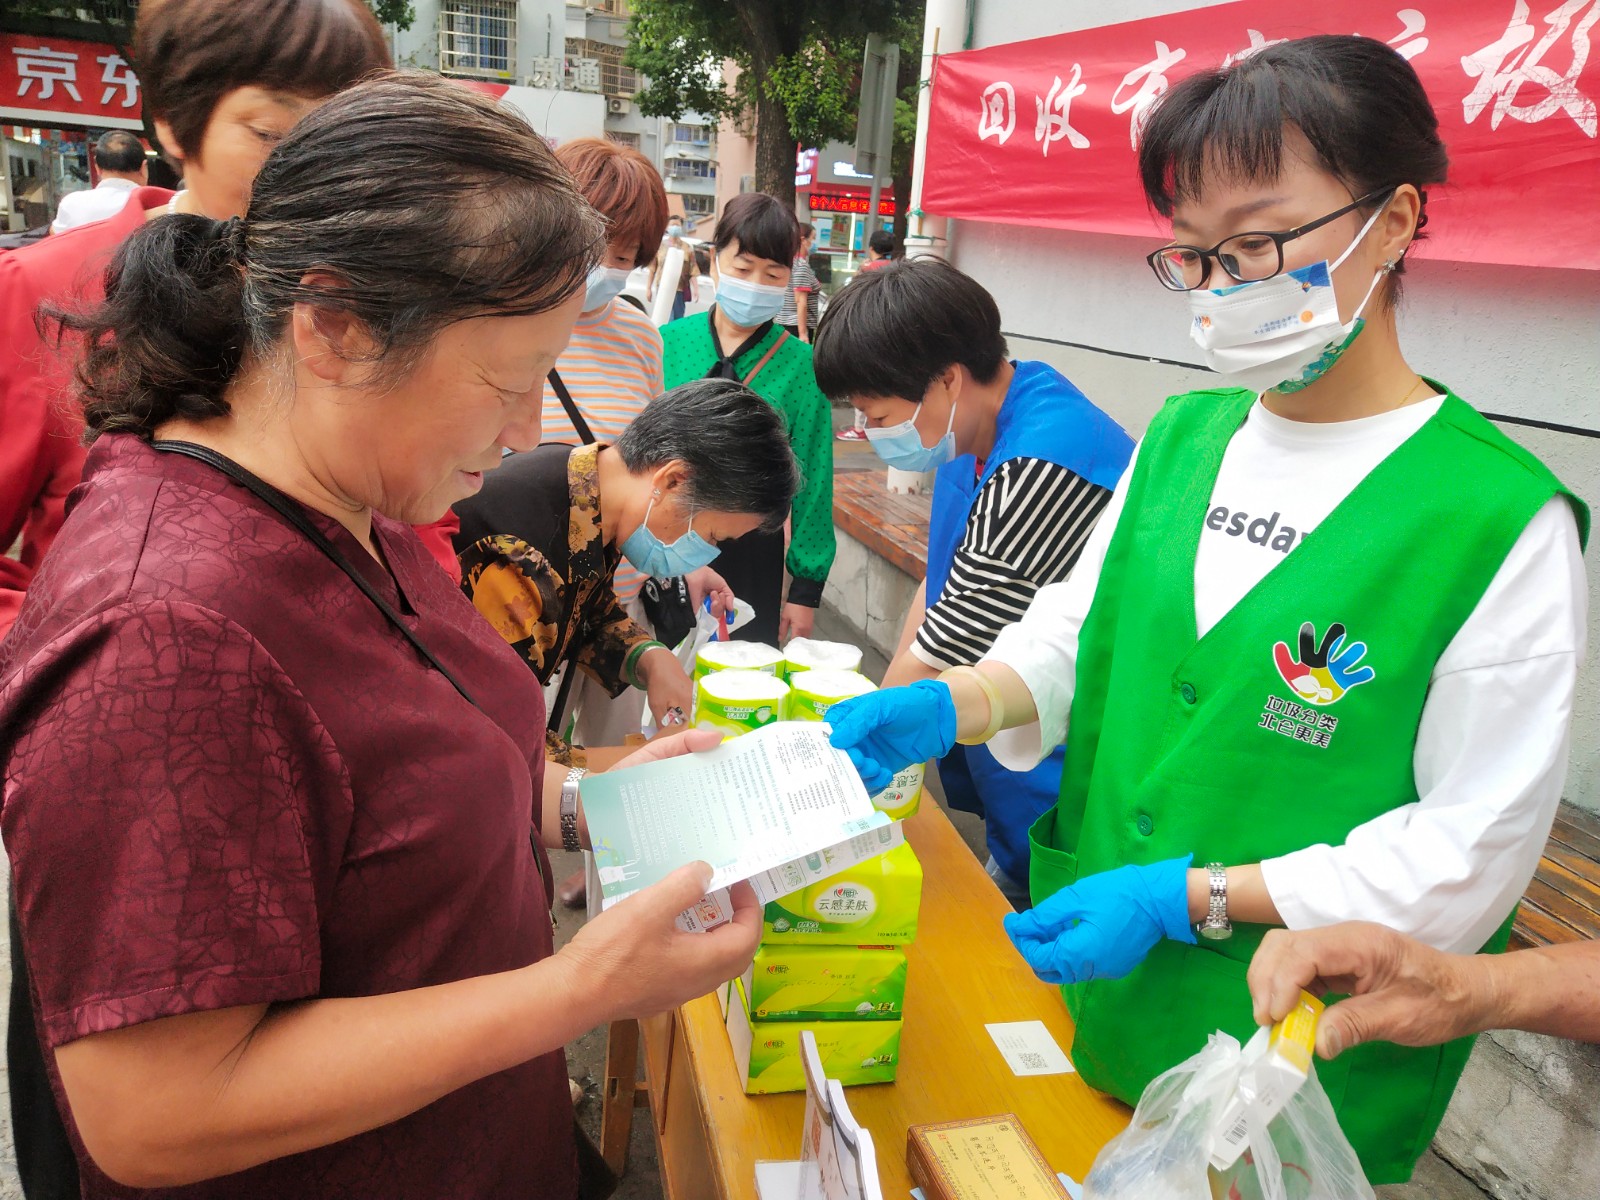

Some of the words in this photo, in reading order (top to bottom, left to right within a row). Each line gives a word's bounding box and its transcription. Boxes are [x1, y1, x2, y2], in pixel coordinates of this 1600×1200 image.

[1206, 503, 1310, 553] esda
[1258, 713, 1331, 748] 北仑更美
[1264, 695, 1338, 732] 垃圾分类
[819, 899, 869, 911] 云感柔肤
